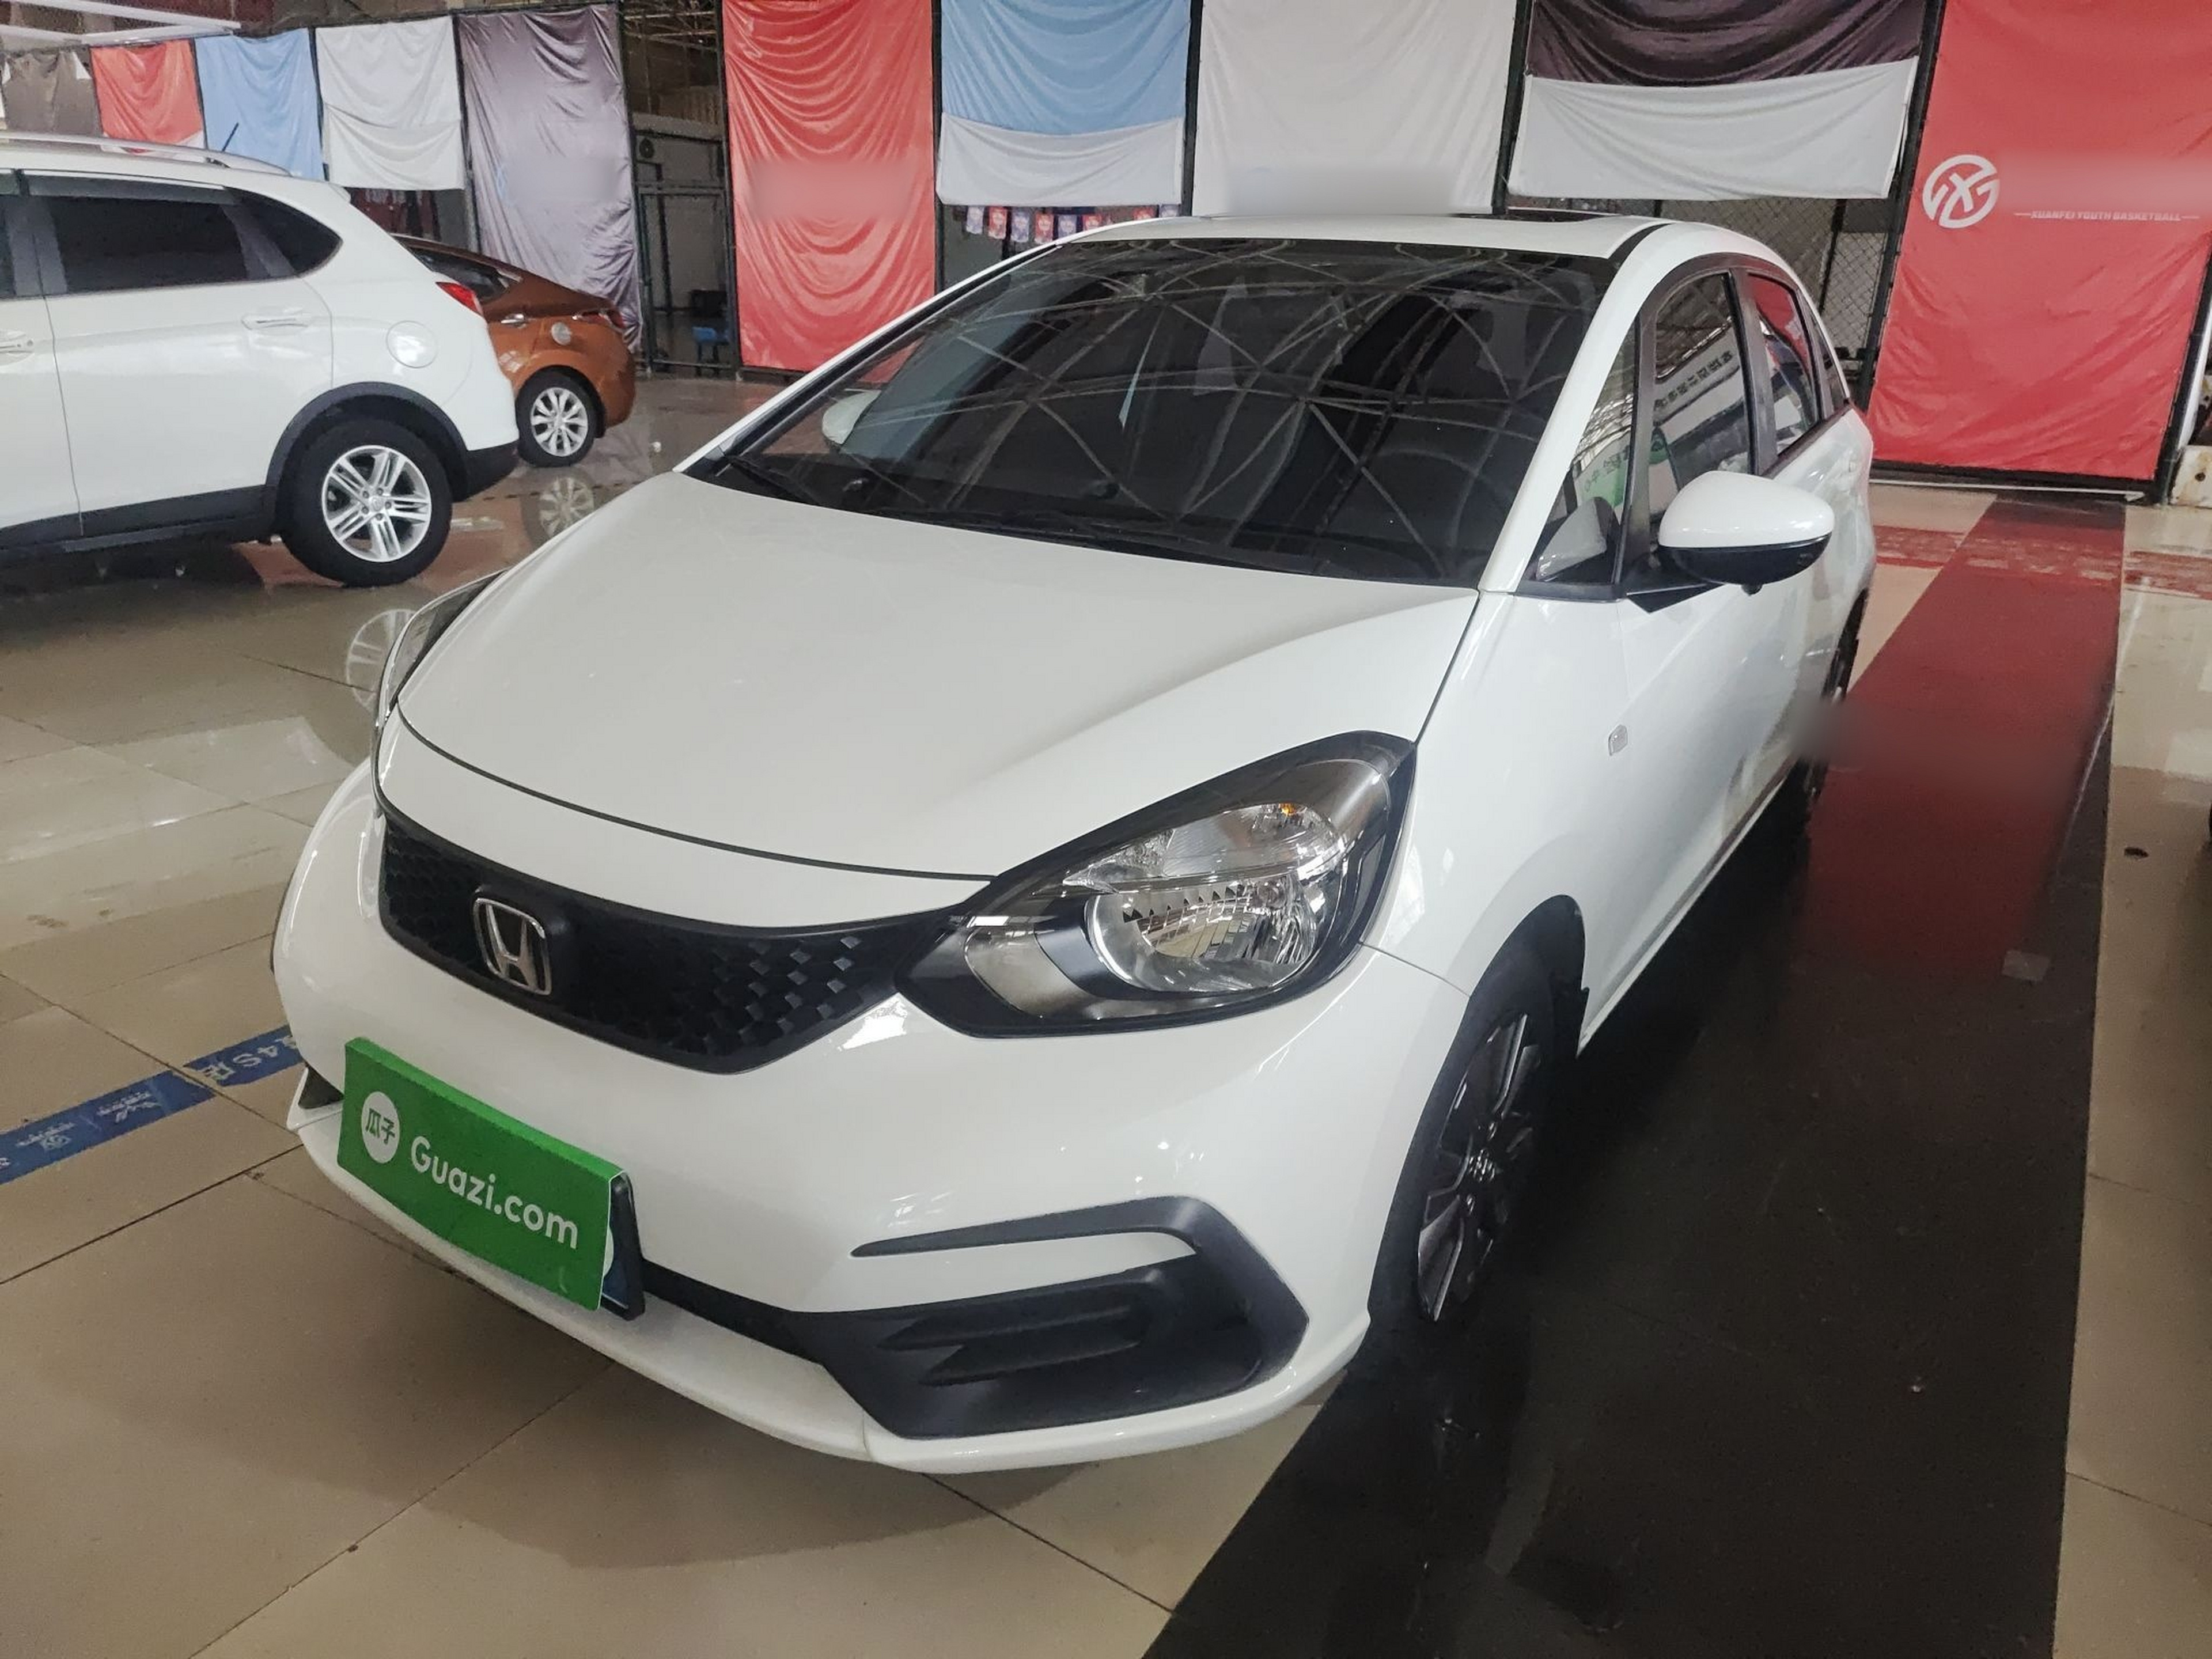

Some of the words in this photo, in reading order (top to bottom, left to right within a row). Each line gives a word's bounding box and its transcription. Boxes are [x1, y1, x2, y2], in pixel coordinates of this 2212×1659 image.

[2077, 211, 2111, 220] YOUTH
[2113, 211, 2181, 221] BASKETBALL
[365, 1108, 395, 1145] 瓜子
[411, 1136, 578, 1249] Guazi.com
